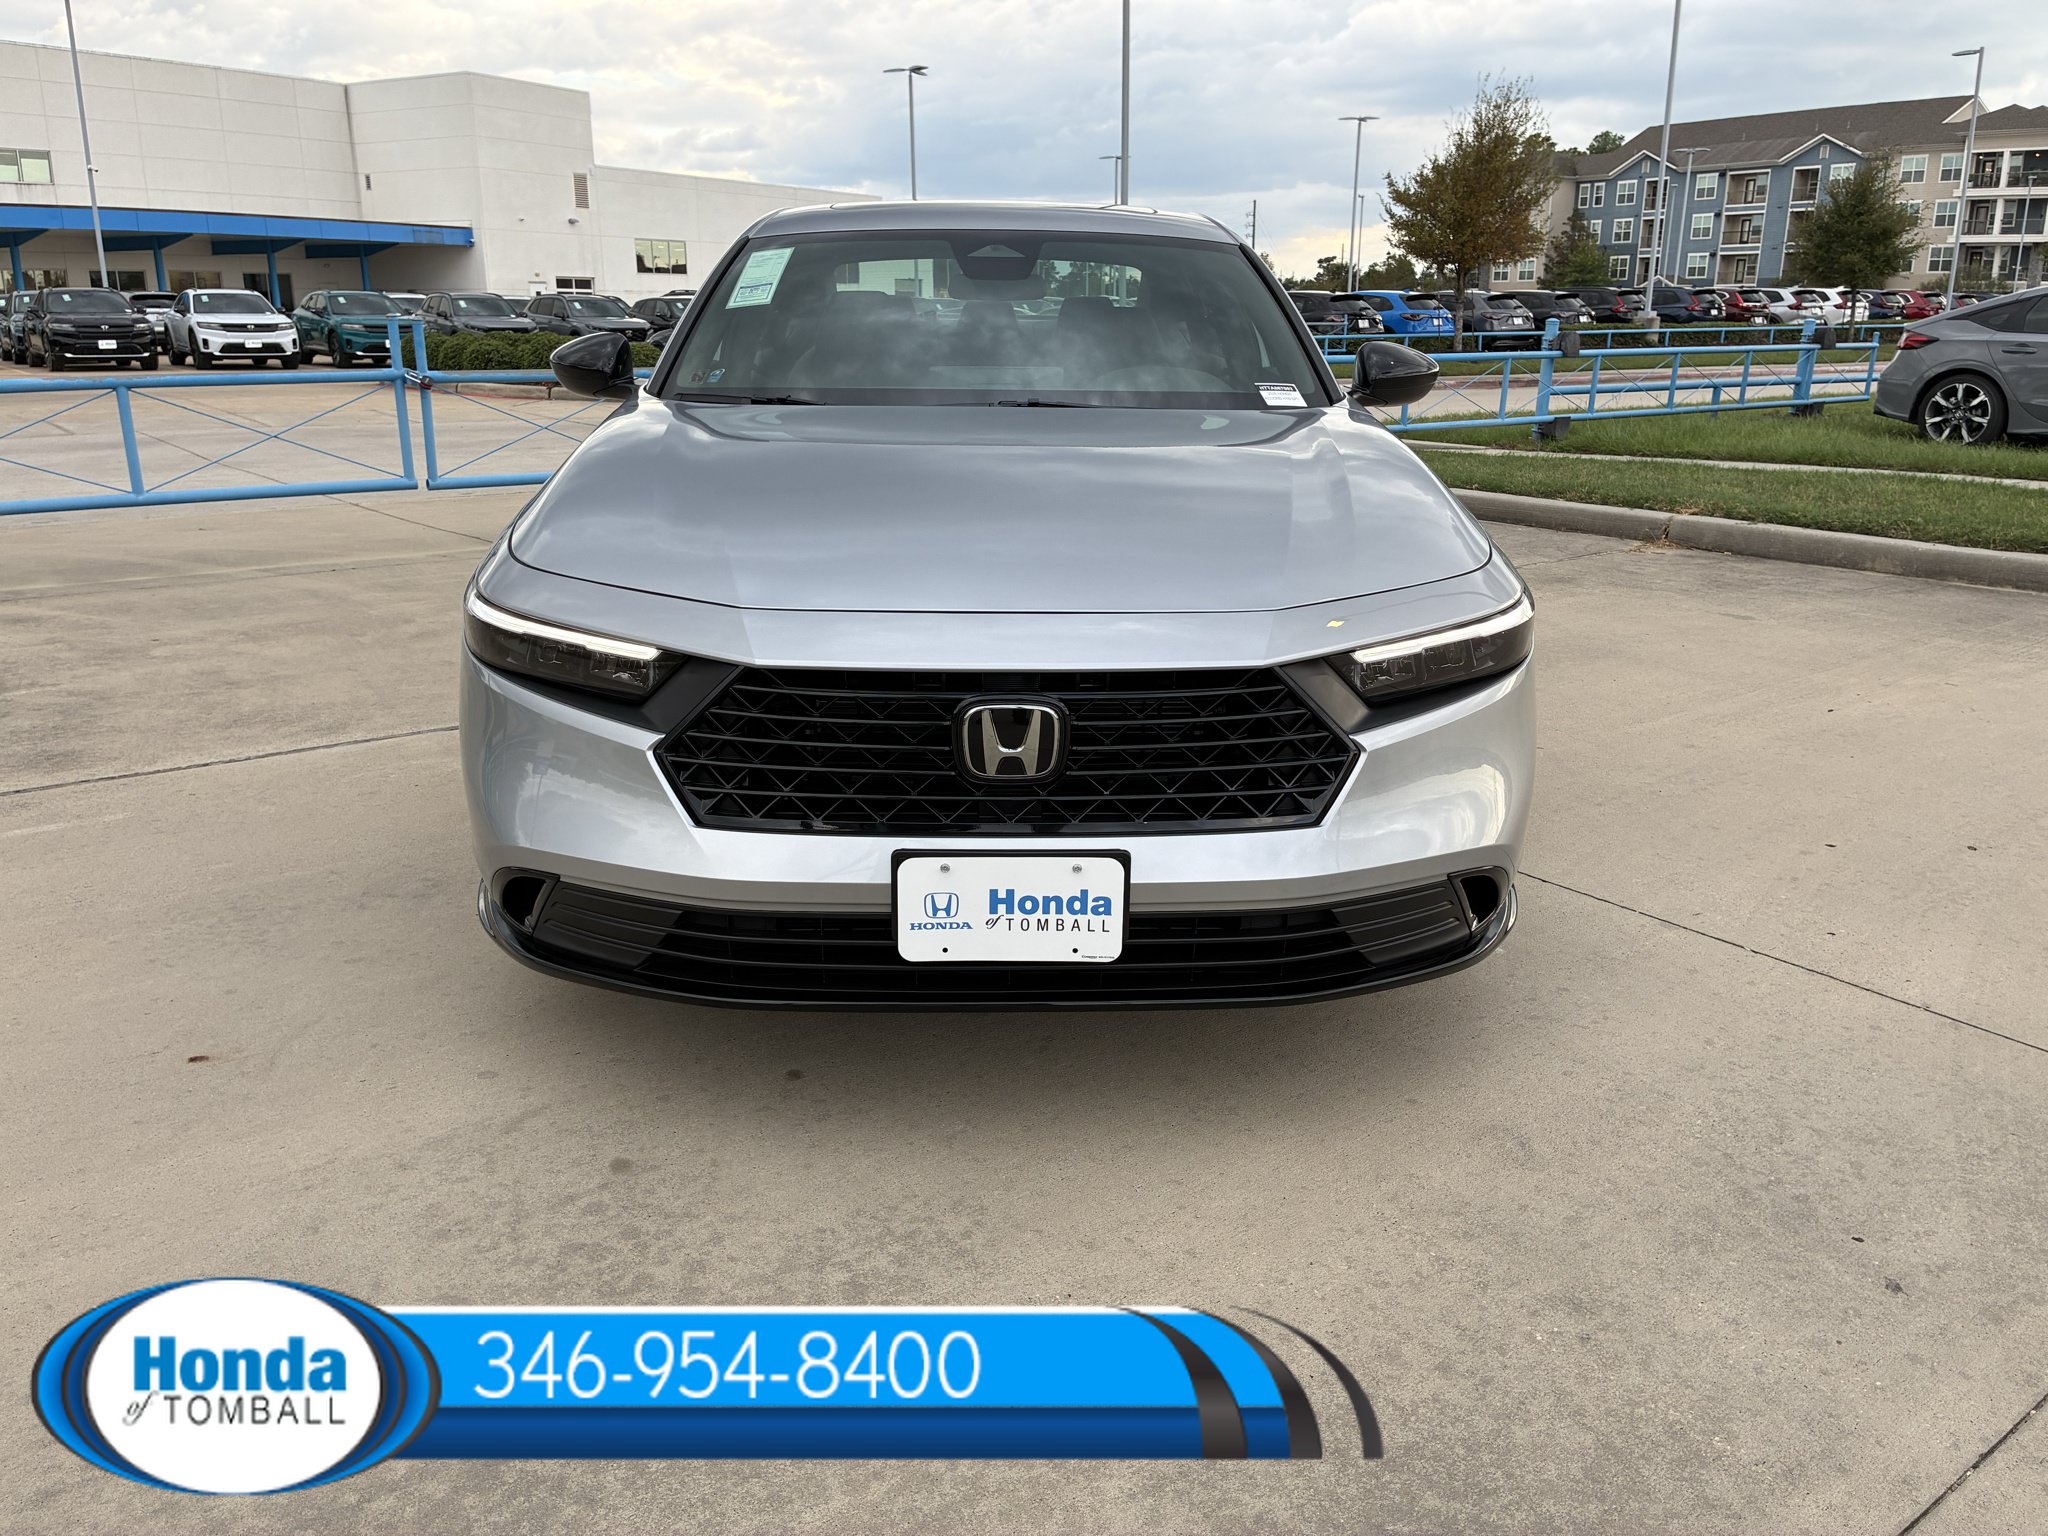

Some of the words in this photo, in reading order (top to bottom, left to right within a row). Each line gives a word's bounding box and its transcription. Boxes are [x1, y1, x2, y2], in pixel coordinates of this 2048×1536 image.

[988, 888, 1112, 916] Honda
[909, 921, 974, 931] HONDA
[985, 914, 1004, 930] of
[1005, 918, 1110, 933] TOMBALL
